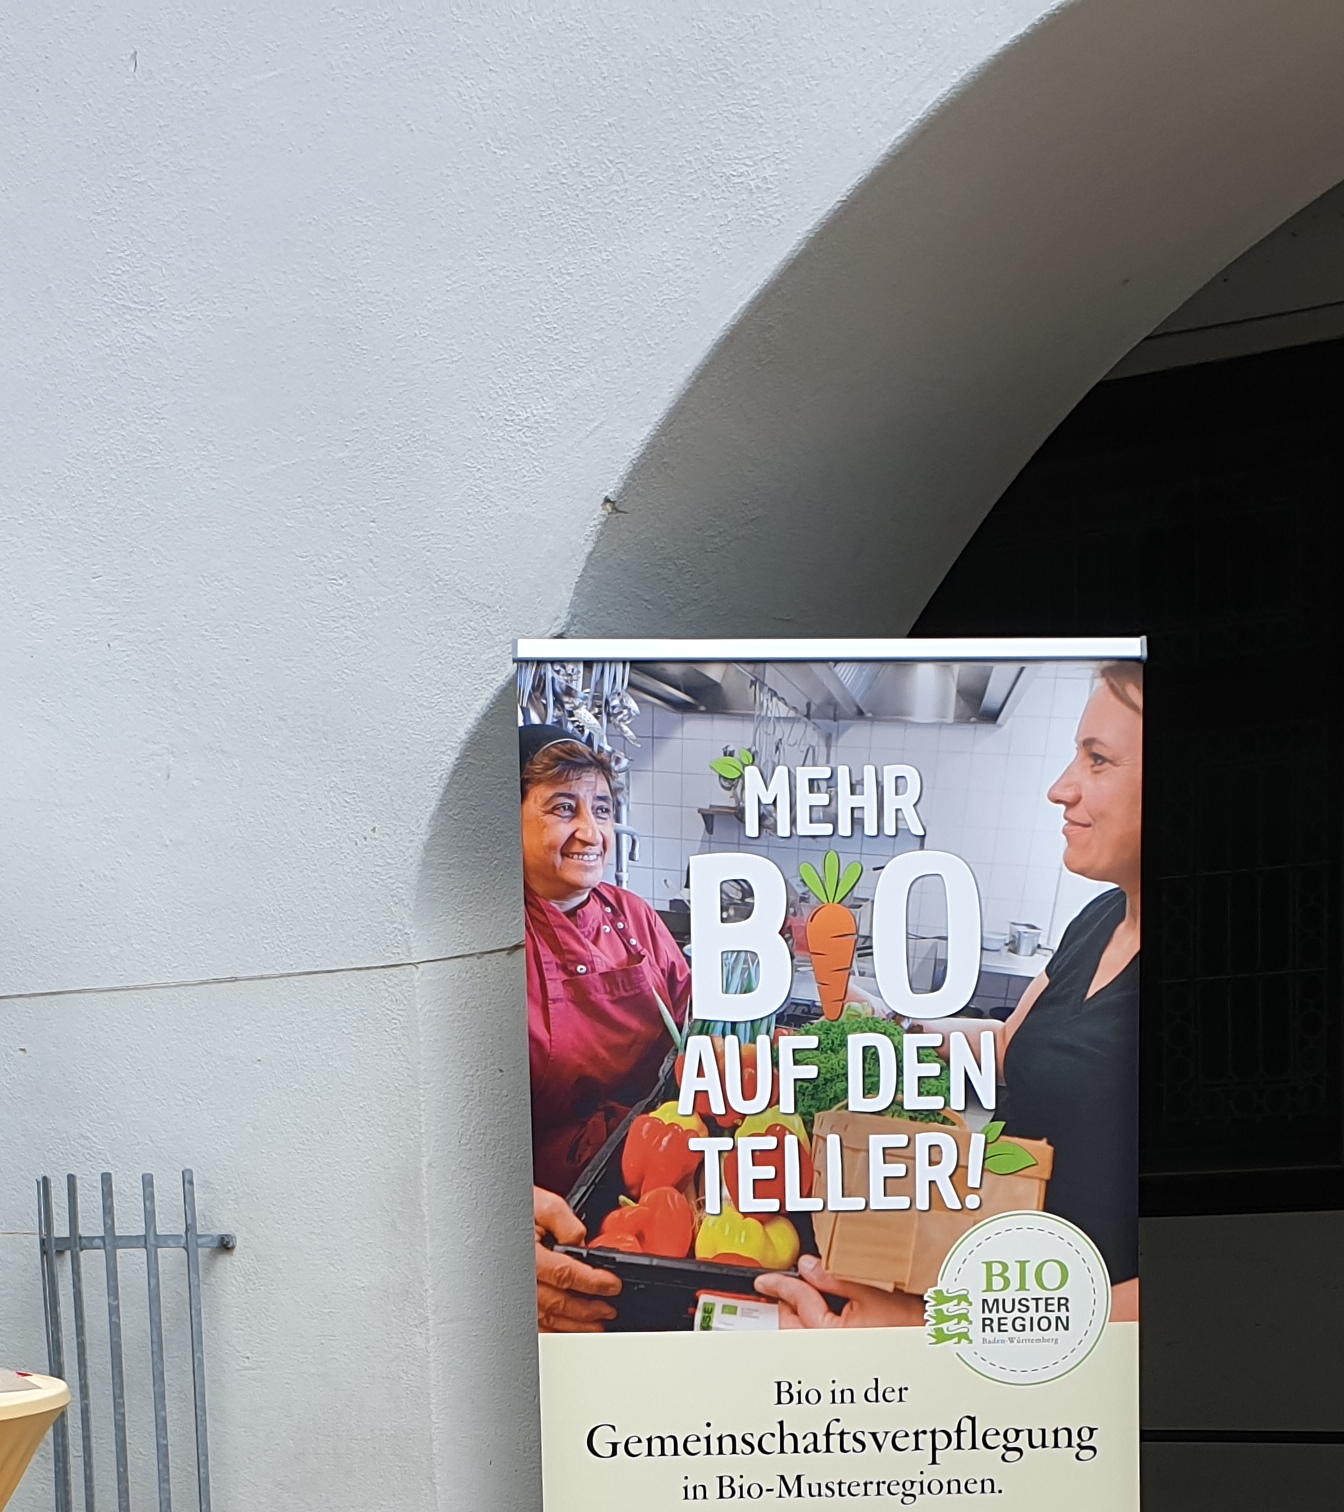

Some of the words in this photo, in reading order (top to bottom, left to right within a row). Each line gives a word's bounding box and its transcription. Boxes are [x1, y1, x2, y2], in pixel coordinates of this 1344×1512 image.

[743, 763, 925, 838] MEHR
[687, 849, 983, 1022] BIO
[677, 1035, 821, 1116] AUF
[847, 1030, 997, 1114] DEN
[687, 1131, 987, 1215] TELLER!
[981, 1259, 1069, 1293] BIO
[982, 1297, 1070, 1314] MUSTER
[982, 1315, 1070, 1333] REGION
[982, 1336, 1059, 1346] Baden-Württemberg
[773, 1380, 822, 1406] Bio
[829, 1379, 856, 1405] in
[863, 1376, 909, 1405] der
[586, 1415, 1098, 1466] Gemeinschaftsverpflegung
[682, 1475, 708, 1501] in
[715, 1470, 1004, 1506] Bio-Musterregionen.
